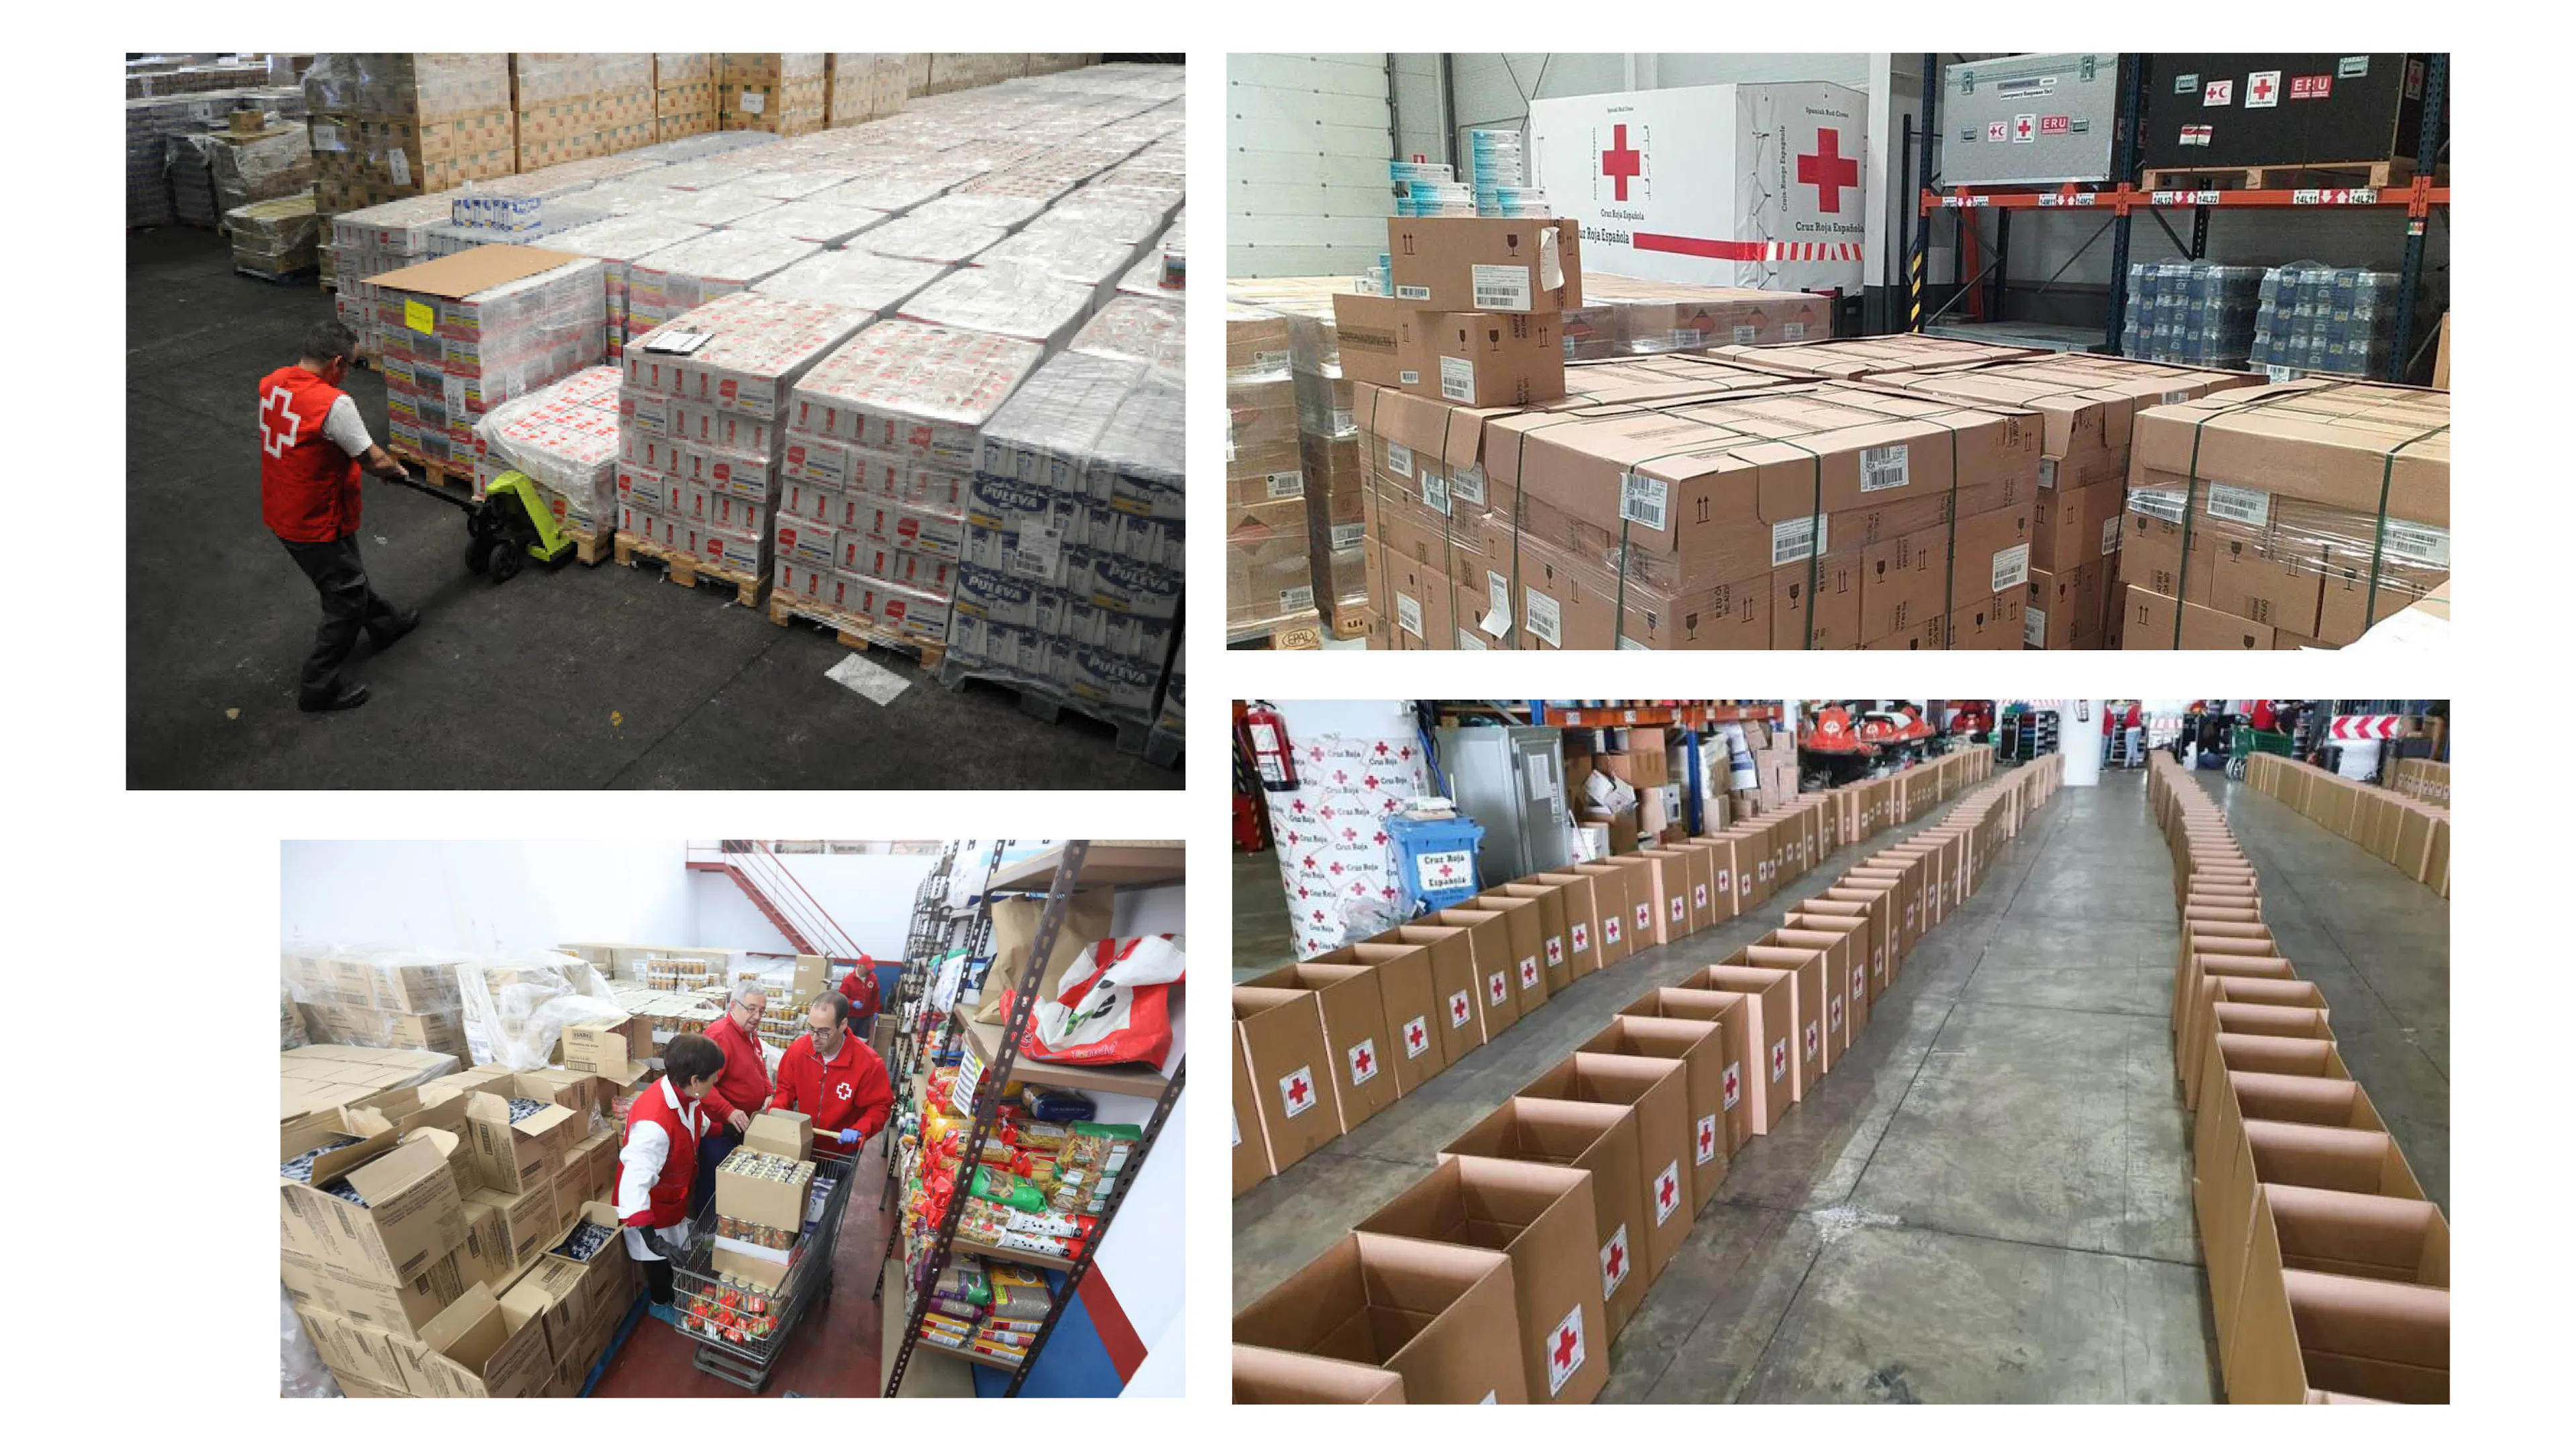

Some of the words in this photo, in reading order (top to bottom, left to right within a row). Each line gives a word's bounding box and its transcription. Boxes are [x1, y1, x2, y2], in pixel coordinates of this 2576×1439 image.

[2294, 76, 2328, 91] ERU
[2042, 117, 2067, 129] ERU
[1601, 209, 1611, 218] Cruz
[1612, 209, 1623, 220] Roja
[1623, 210, 1644, 221] Española
[1795, 221, 1814, 231] Cruz
[1815, 222, 1831, 234] Roja
[1833, 223, 1865, 234] Española
[1587, 226, 1601, 244] Roja
[1602, 227, 1629, 246] Española
[981, 483, 1038, 508] PULEVA
[1108, 564, 1170, 592] PULEVA
[969, 573, 1022, 600] PULEVA
[1288, 633, 1309, 645] EPAL
[1087, 656, 1147, 684] PULEVA
[1328, 749, 1342, 757] Cruz
[1345, 749, 1361, 758] Roja
[1385, 757, 1397, 766] Roja
[1395, 776, 1407, 785] Roja
[1354, 808, 1370, 816] Roja
[1313, 835, 1328, 843] Roja
[1424, 855, 1443, 865] Cruz
[1446, 853, 1465, 865] Roja
[1363, 863, 1379, 871] Roja
[1429, 877, 1466, 888] Española
[1310, 889, 1322, 897] Cruz
[1323, 889, 1337, 898] Roja
